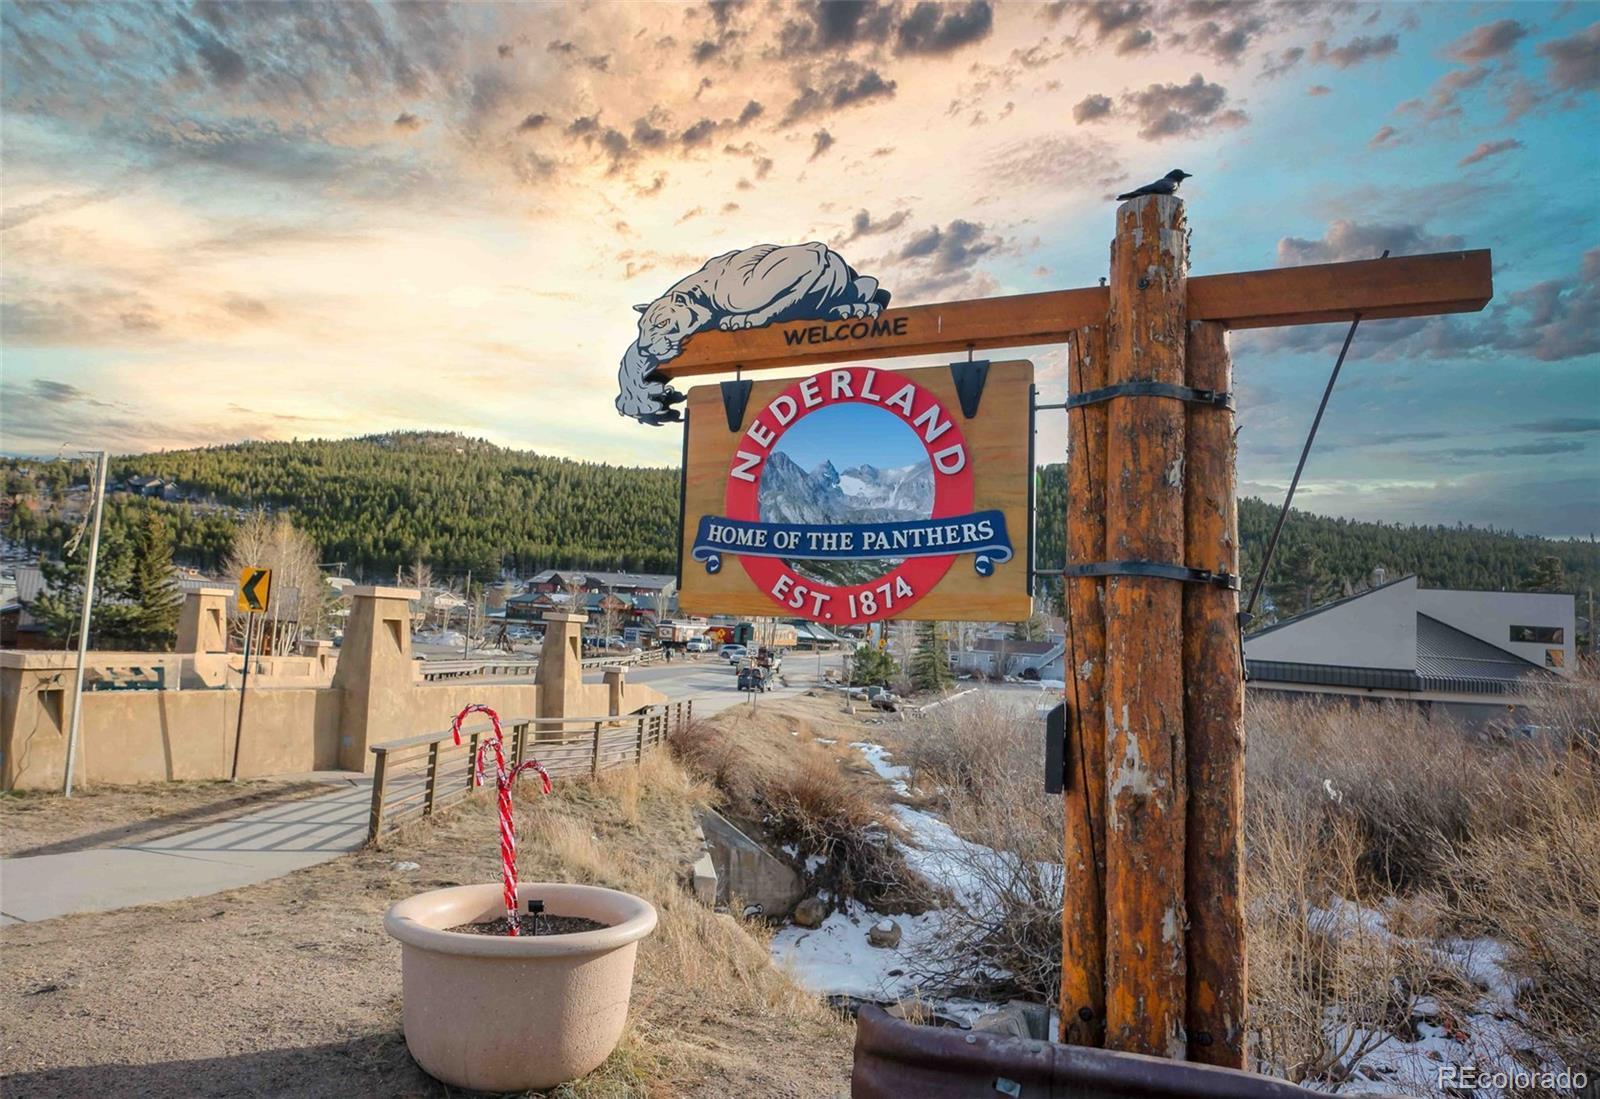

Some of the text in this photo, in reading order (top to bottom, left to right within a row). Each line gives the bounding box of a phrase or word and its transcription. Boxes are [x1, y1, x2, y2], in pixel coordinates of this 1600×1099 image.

[784, 319, 908, 345] WELCOME
[731, 370, 966, 482] NEDERLAND
[708, 520, 994, 551] HOME OF THE PANTHERS
[771, 575, 913, 619] EST. 1874
